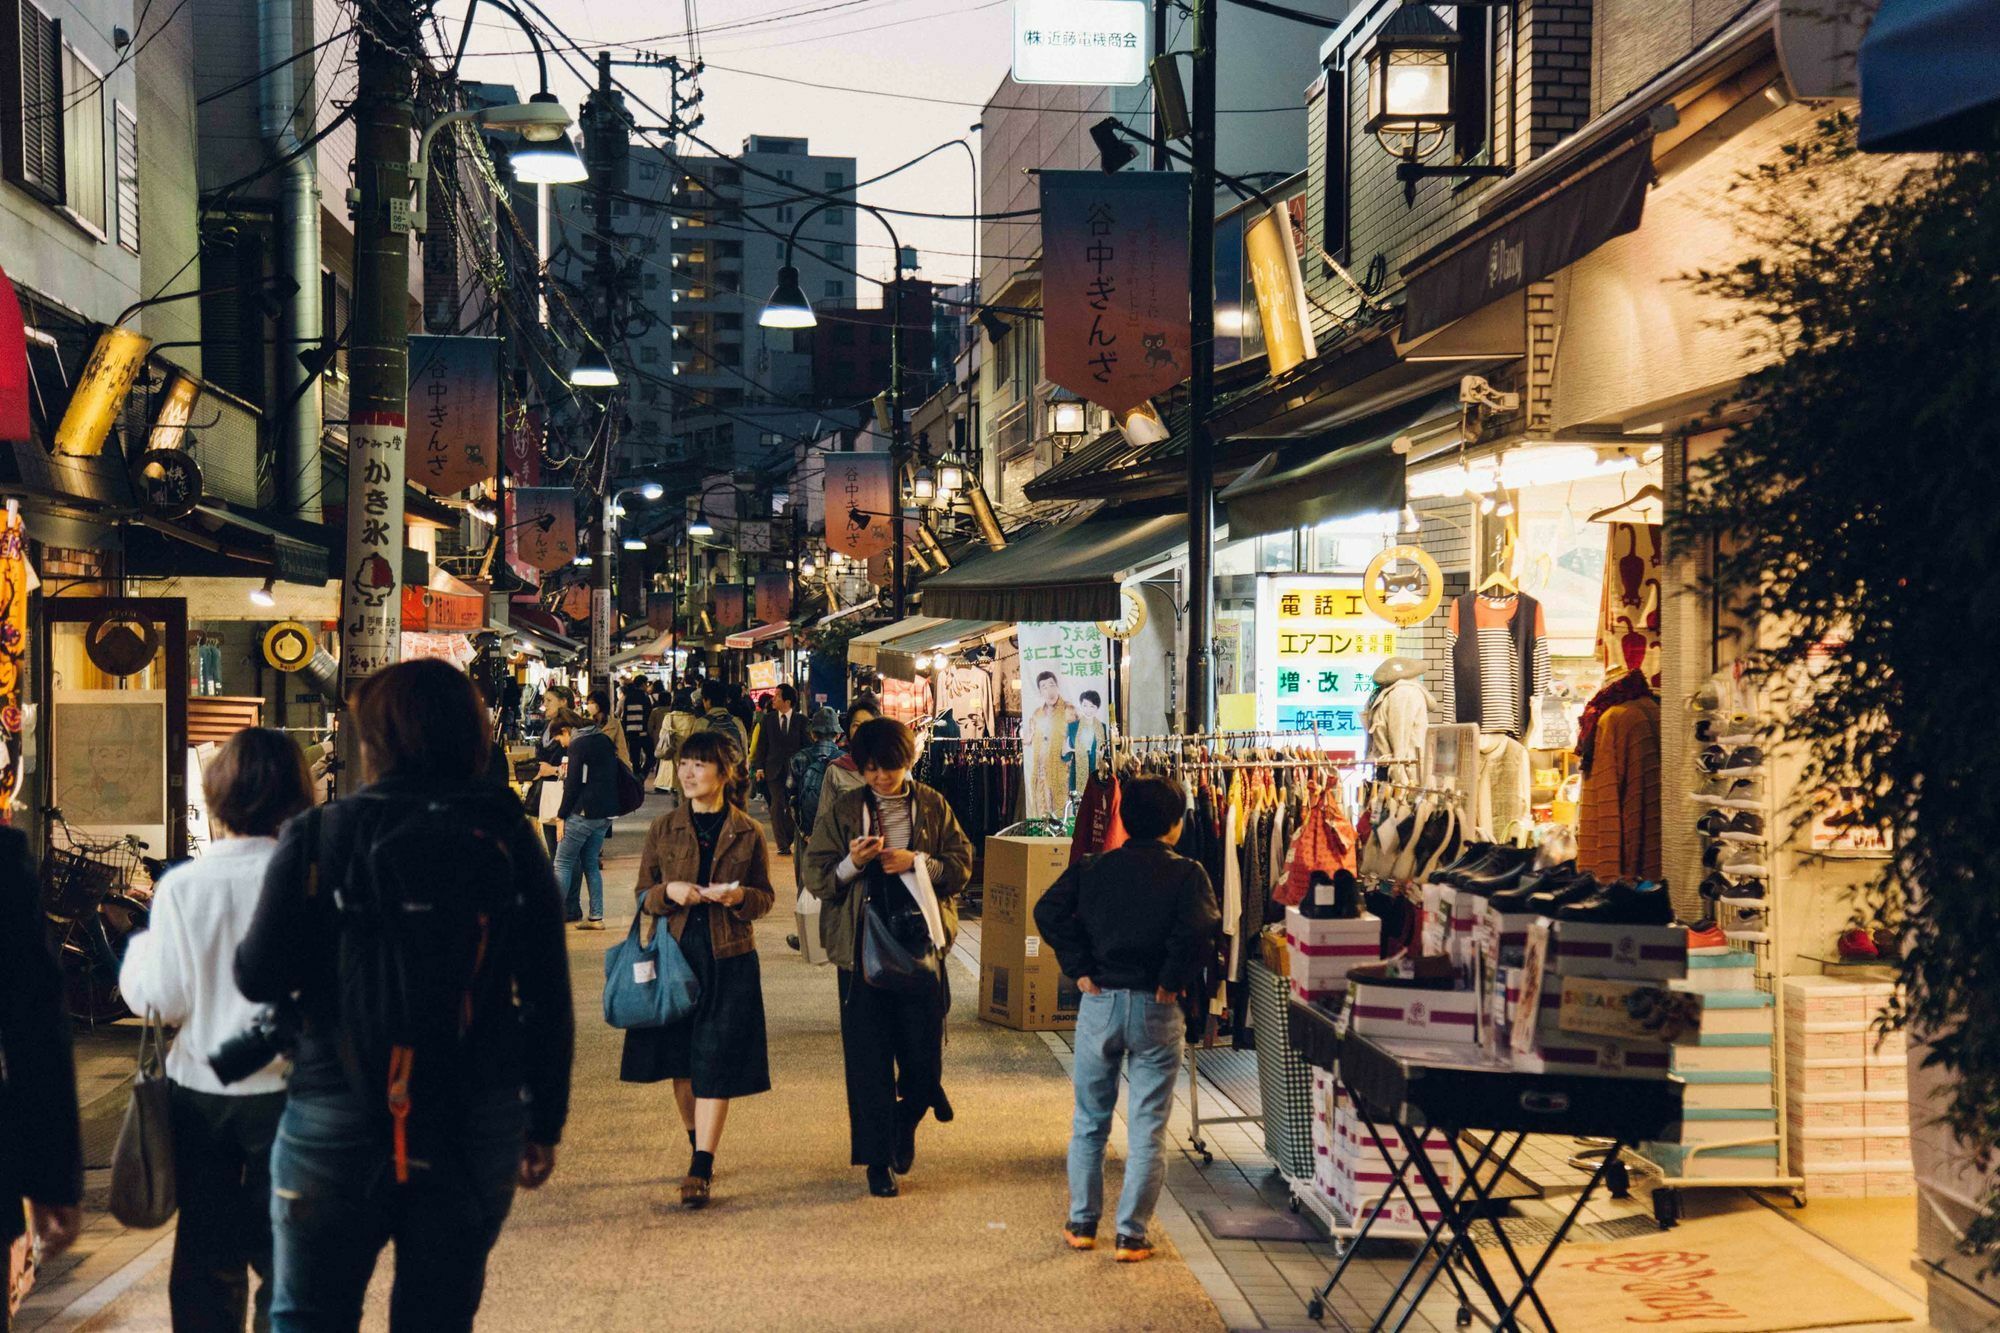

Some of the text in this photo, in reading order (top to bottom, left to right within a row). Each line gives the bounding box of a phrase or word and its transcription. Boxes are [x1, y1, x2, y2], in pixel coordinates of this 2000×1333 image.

[1086, 202, 1118, 384] 谷中ぎんざ
[354, 434, 402, 451] ひみつ堂
[361, 458, 392, 547] かき氷
[1281, 594, 1386, 616] 電話工
[1280, 633, 1352, 654] エアコン
[1279, 709, 1363, 731] 一般電気
